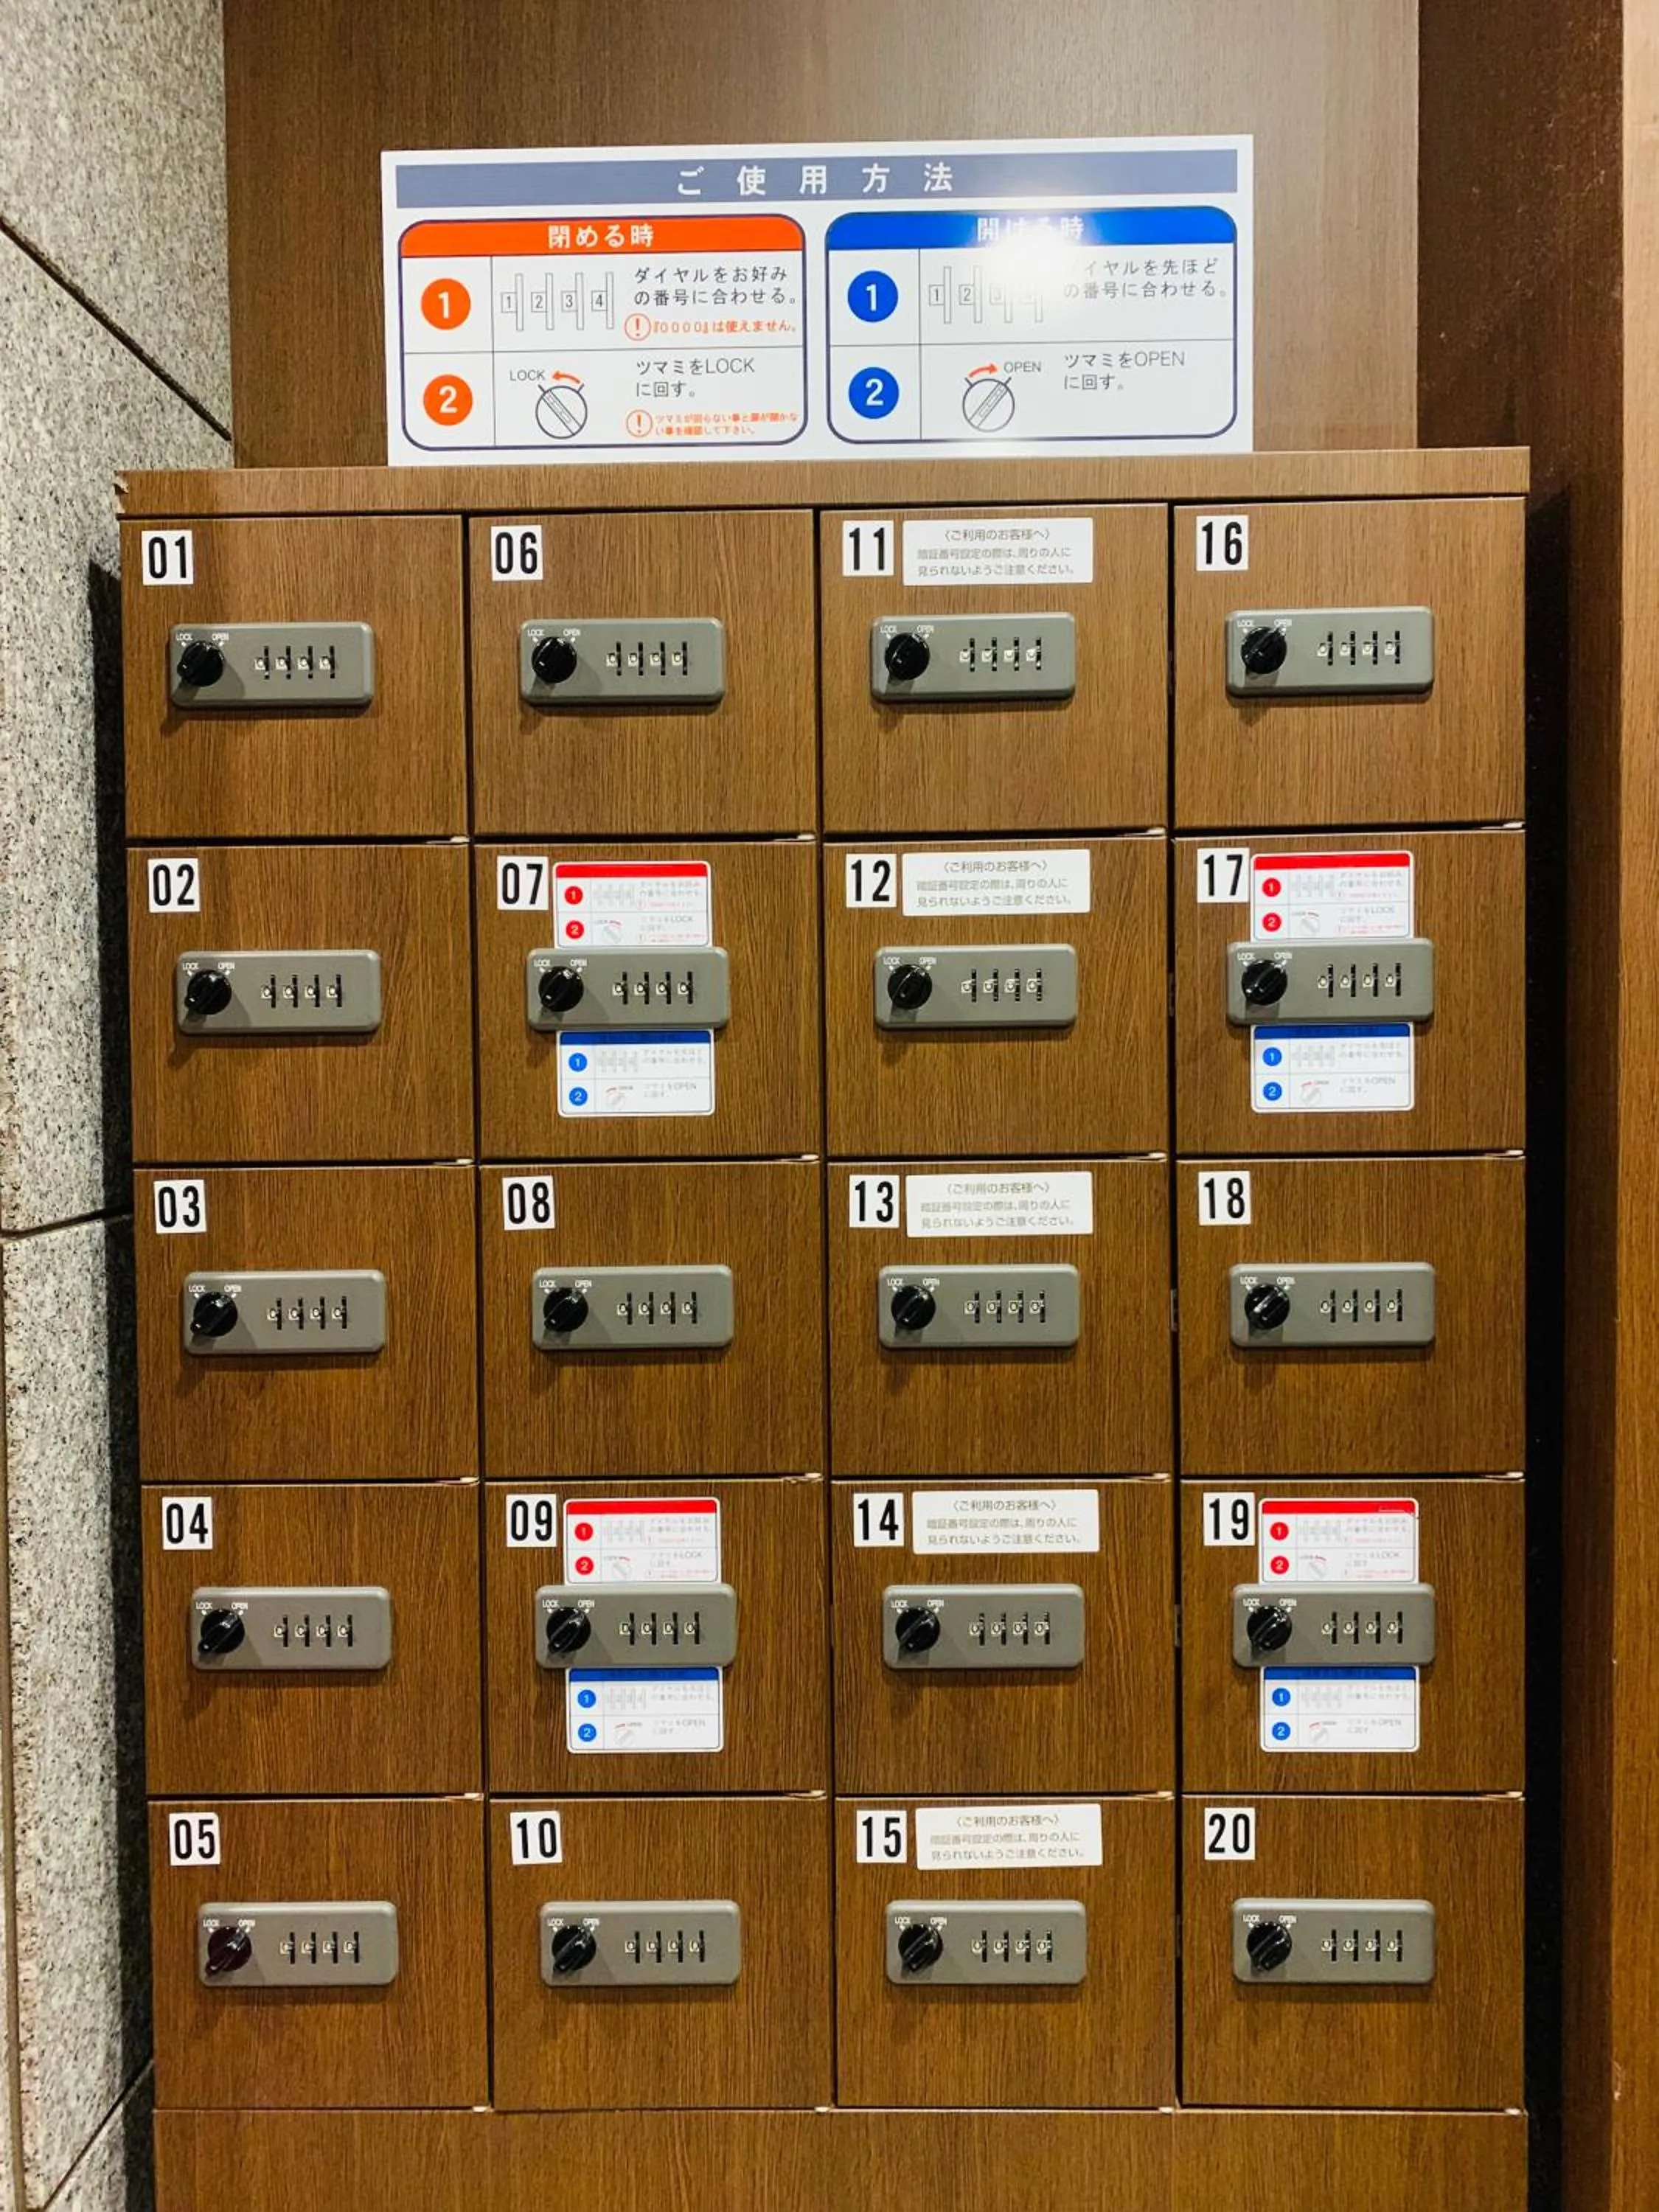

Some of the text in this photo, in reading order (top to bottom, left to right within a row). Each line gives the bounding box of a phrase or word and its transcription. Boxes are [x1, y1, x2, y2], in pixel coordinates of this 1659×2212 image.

[678, 162, 953, 195] ご使用方法
[549, 224, 654, 248] 閉める時
[634, 266, 787, 285] ダイヤルをお好み
[1065, 258, 1218, 276] イヤルを先ほど
[439, 292, 449, 319] 1
[506, 294, 603, 309] 1 2 3 4
[634, 287, 796, 306] の番号に合わせる。
[865, 283, 877, 311] 1
[1064, 281, 1227, 299] の番号に合わせる。
[509, 370, 546, 381] LOCK
[636, 358, 756, 375] ツマミをLOCK
[1004, 361, 1042, 372] OPEN
[1064, 352, 1186, 368] ツマミをOPEN
[439, 386, 458, 413] 2
[636, 380, 695, 397] に回す。
[866, 378, 884, 406] 2
[1064, 375, 1123, 391] に回す。
[148, 537, 187, 578] 01
[495, 532, 538, 574] 06
[849, 528, 885, 571] 11
[1201, 522, 1242, 565] 16
[153, 864, 195, 905] 02
[501, 863, 543, 905] 07
[851, 860, 891, 902] 12
[1204, 855, 1244, 896] 17
[159, 1185, 200, 1227] 03
[508, 1182, 550, 1224] 08
[855, 1180, 894, 1222] 13
[1204, 1178, 1245, 1219] 18
[166, 1503, 208, 1544] 04
[511, 1500, 553, 1541] 09
[858, 1499, 899, 1540] 14
[1209, 1498, 1250, 1540] 19
[174, 1819, 215, 1859] 05
[517, 1818, 557, 1858] 10
[862, 1816, 901, 1857] 15
[1208, 1813, 1250, 1853] 20
